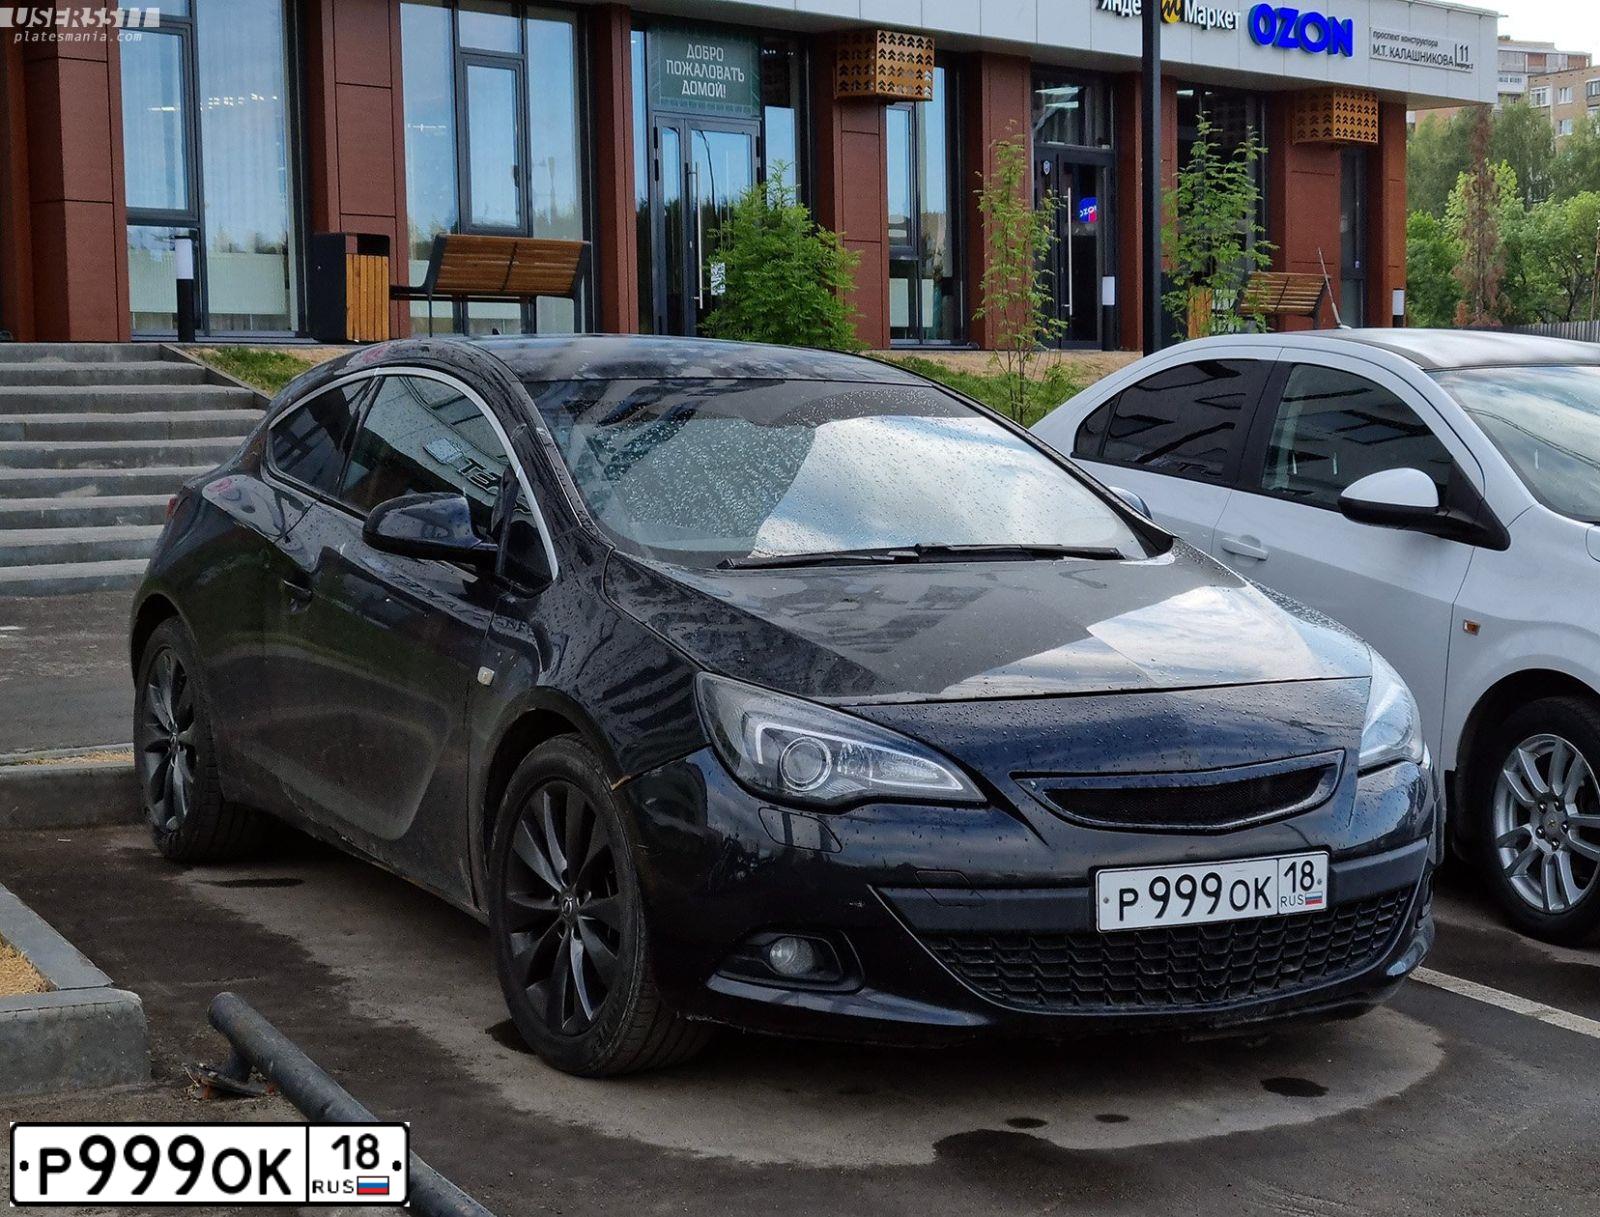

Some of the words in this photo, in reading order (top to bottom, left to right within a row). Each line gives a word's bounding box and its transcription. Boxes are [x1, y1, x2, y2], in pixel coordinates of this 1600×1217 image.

[1184, 0, 1240, 30] Маркет
[1248, 3, 1353, 57] OZON
[686, 43, 724, 61] ДОБРО
[1389, 46, 1454, 66] КАЛАШНИКОВА
[1459, 44, 1469, 62] 11
[666, 59, 745, 82] ПОЖАЛОВАТЬ
[681, 80, 726, 98] ДОМОЙ!
[1283, 860, 1315, 893] 18
[1280, 896, 1304, 908] RUS
